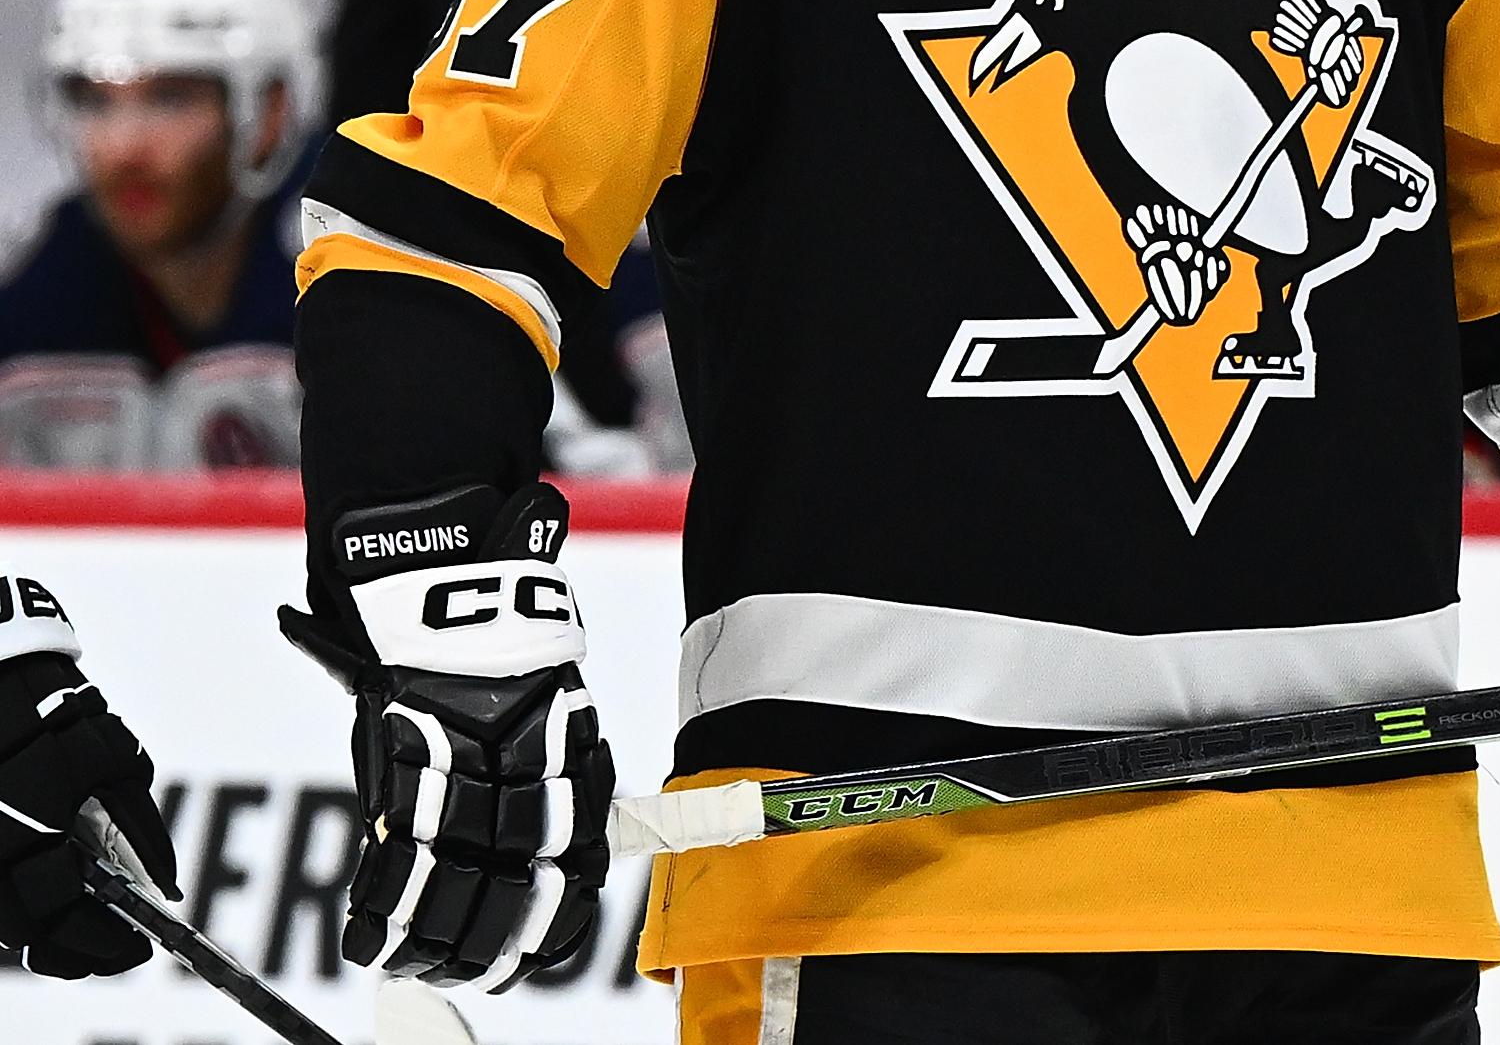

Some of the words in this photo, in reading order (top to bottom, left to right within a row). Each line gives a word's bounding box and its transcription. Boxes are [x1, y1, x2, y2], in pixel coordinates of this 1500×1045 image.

[344, 524, 470, 561] PENGUINS
[528, 519, 560, 554] 87
[421, 575, 585, 631] CC
[784, 780, 941, 824] CCM
